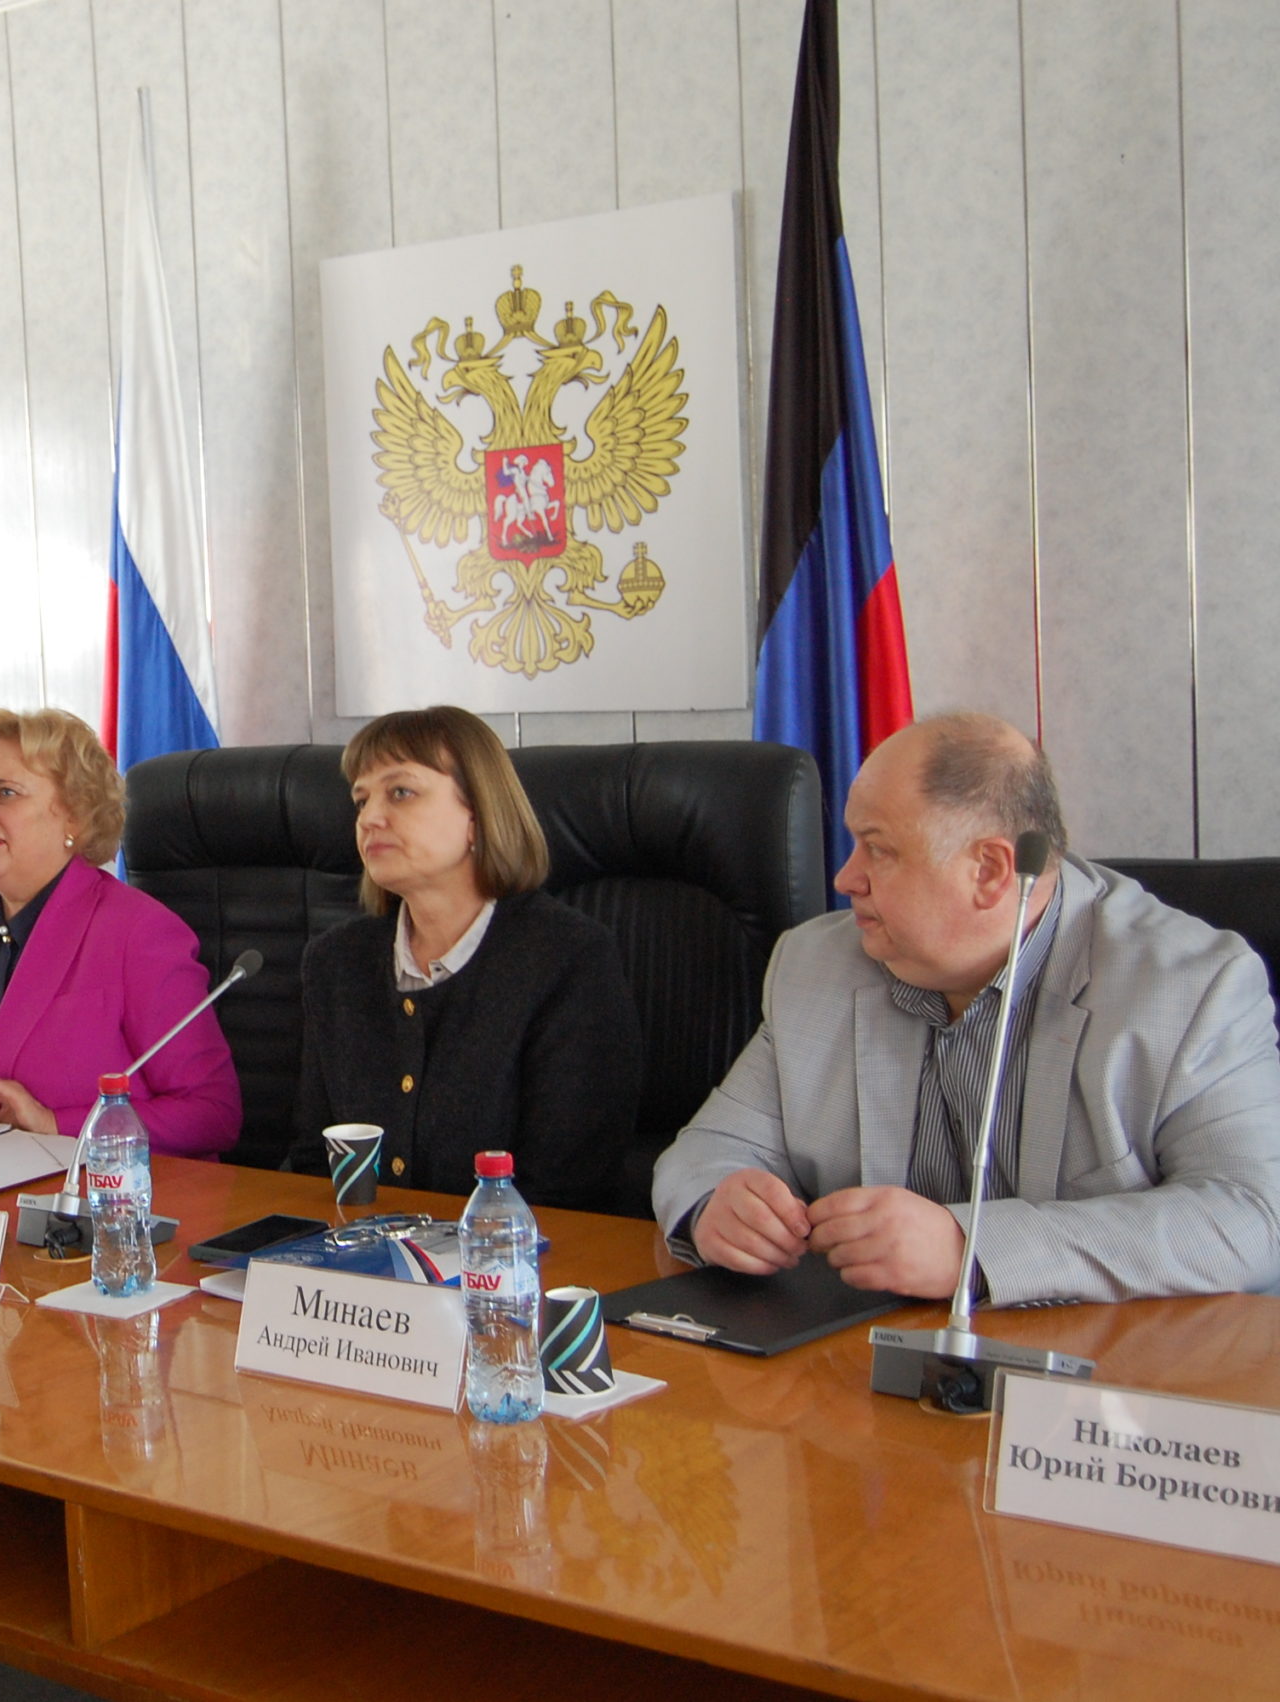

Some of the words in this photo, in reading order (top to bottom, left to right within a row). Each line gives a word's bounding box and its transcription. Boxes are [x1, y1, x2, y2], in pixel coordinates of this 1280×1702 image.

[291, 1285, 410, 1335] Минаев
[256, 1325, 329, 1359] Андрей
[335, 1339, 439, 1377] Иванович
[1072, 1417, 1242, 1469] Николаев
[1008, 1444, 1105, 1482] Юрий
[1115, 1462, 1280, 1514] Борисови
